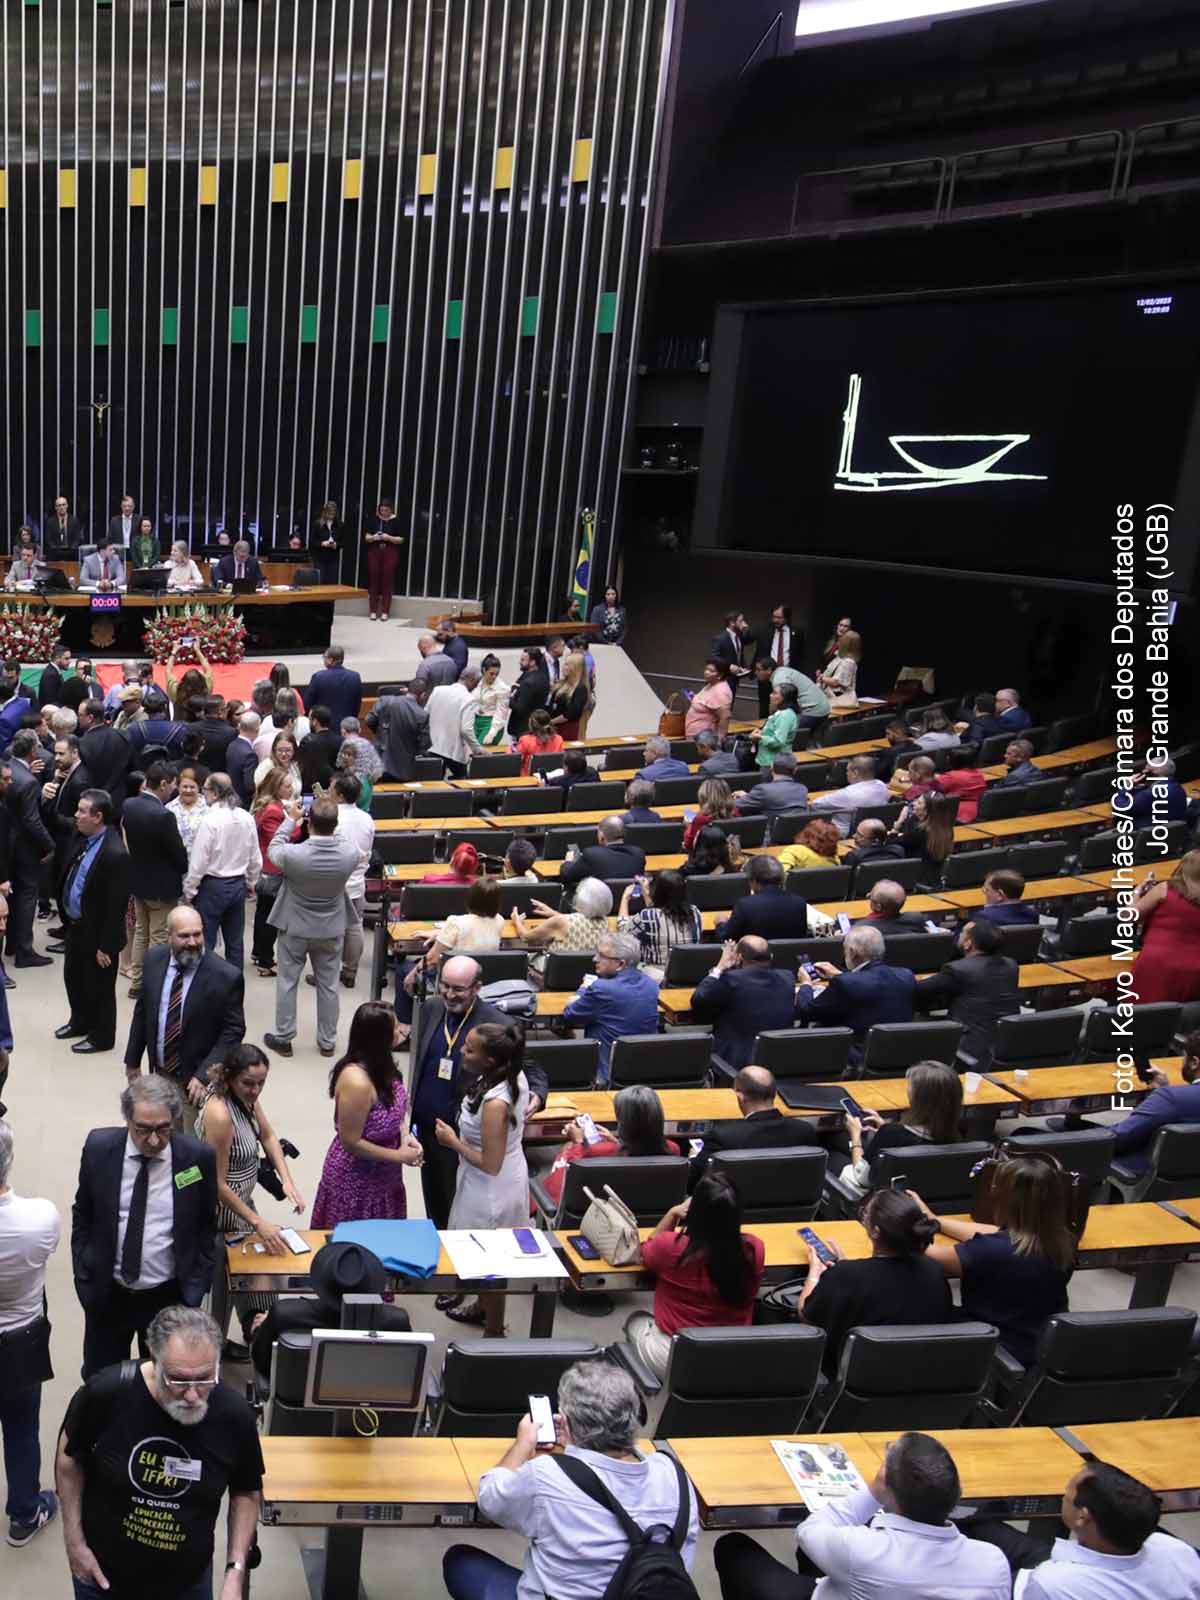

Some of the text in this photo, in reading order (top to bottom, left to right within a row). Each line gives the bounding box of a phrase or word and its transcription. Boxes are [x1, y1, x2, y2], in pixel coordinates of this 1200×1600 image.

[92, 598, 118, 607] 00:00
[139, 1451, 157, 1466] EU
[146, 1500, 180, 1510] QUERO
